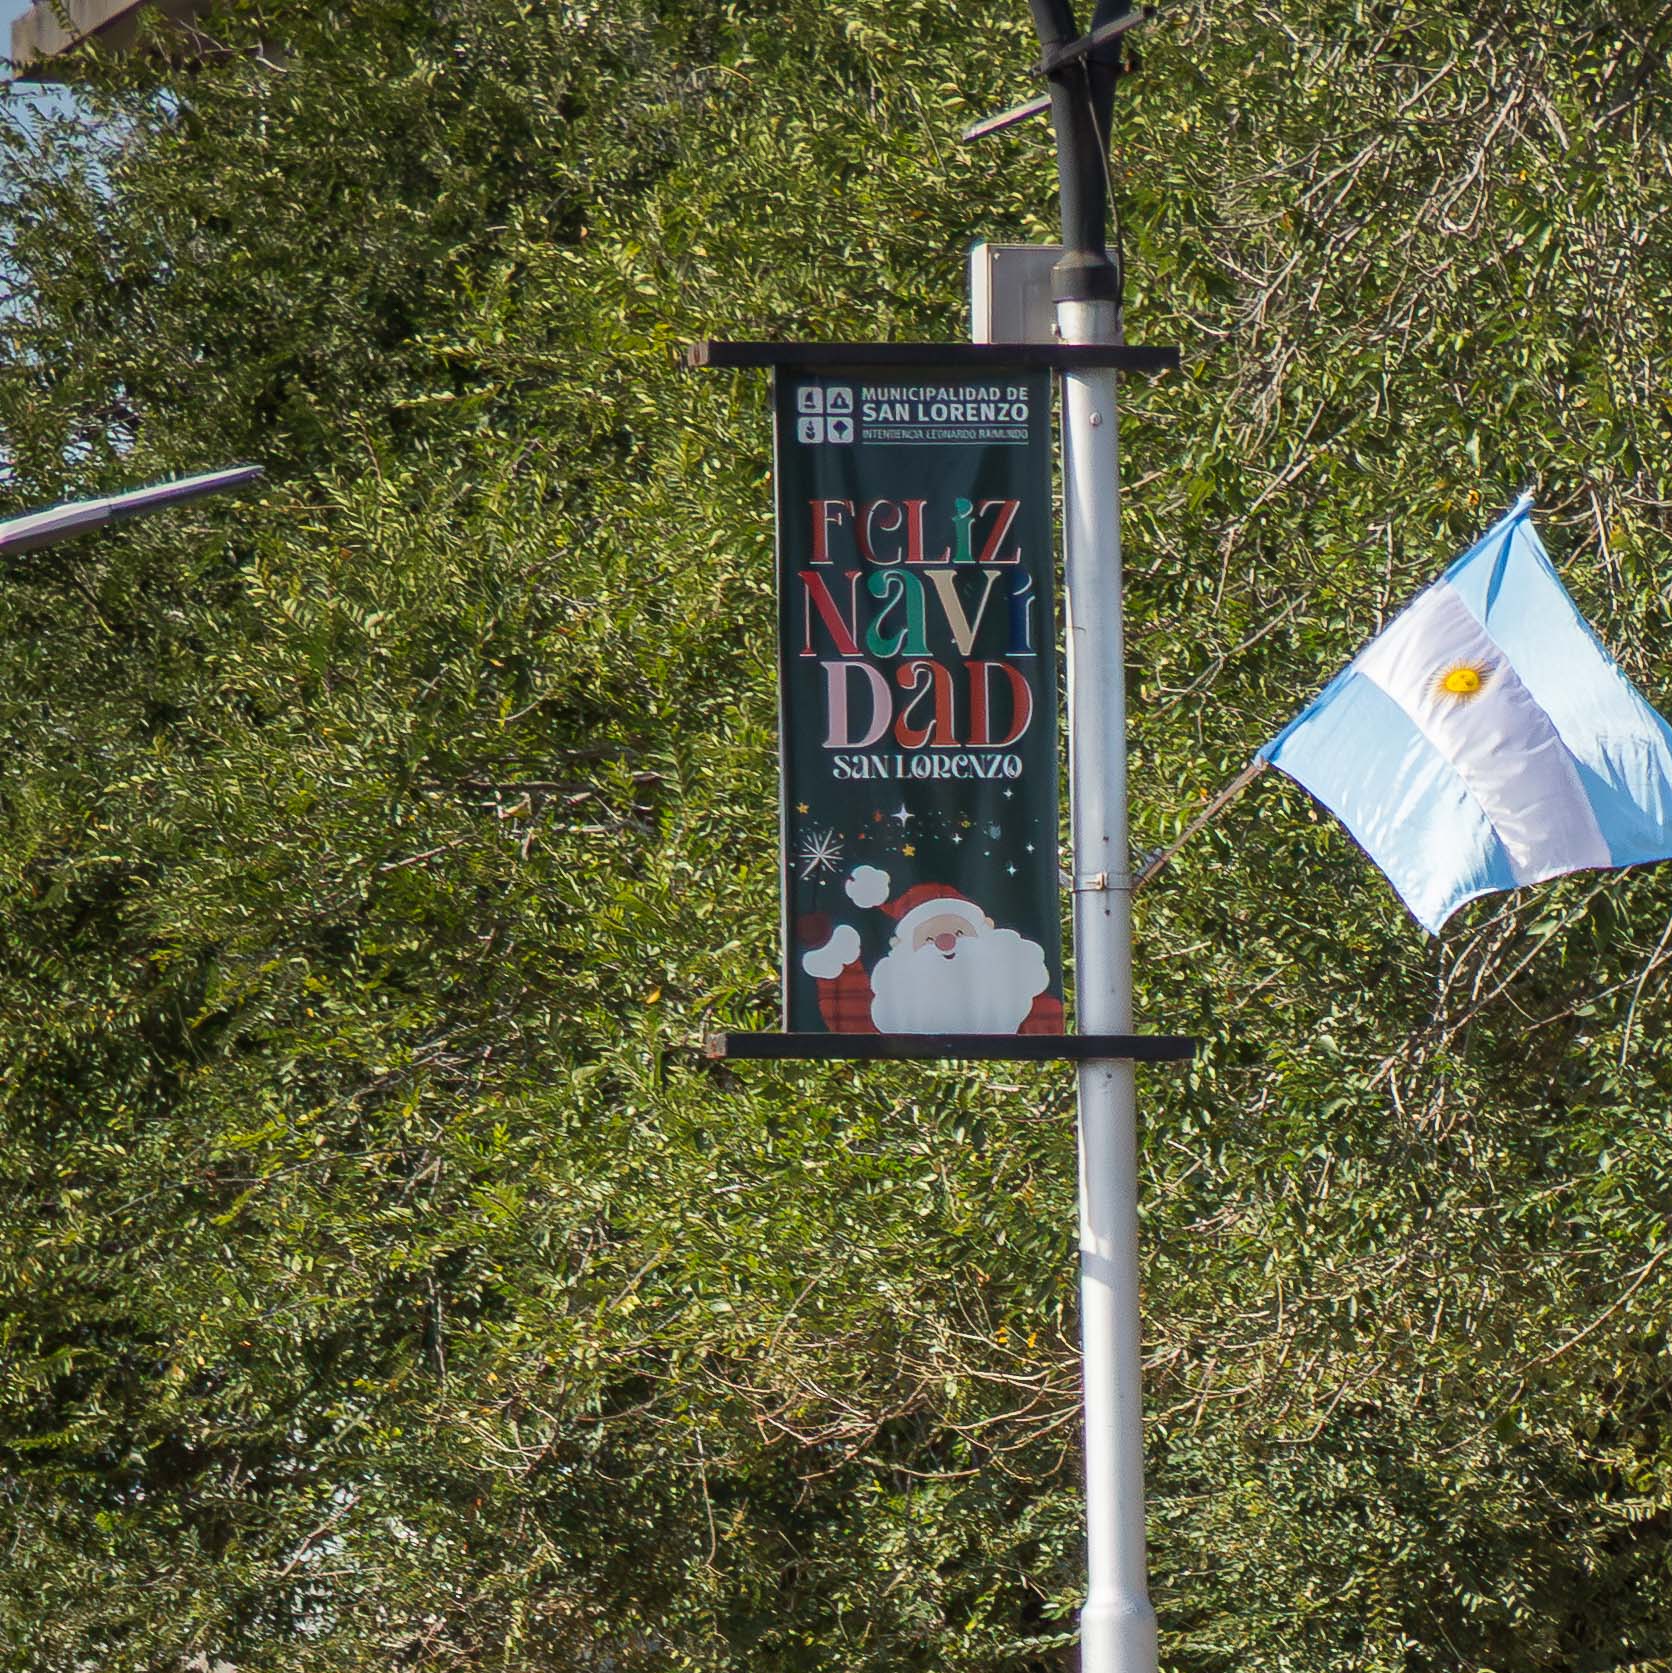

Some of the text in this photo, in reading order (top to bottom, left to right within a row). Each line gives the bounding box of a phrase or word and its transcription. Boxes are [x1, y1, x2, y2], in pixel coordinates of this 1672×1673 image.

[861, 386, 1029, 401] MUNICIPALIDAD DE
[861, 403, 1029, 422] SAN LORENZO
